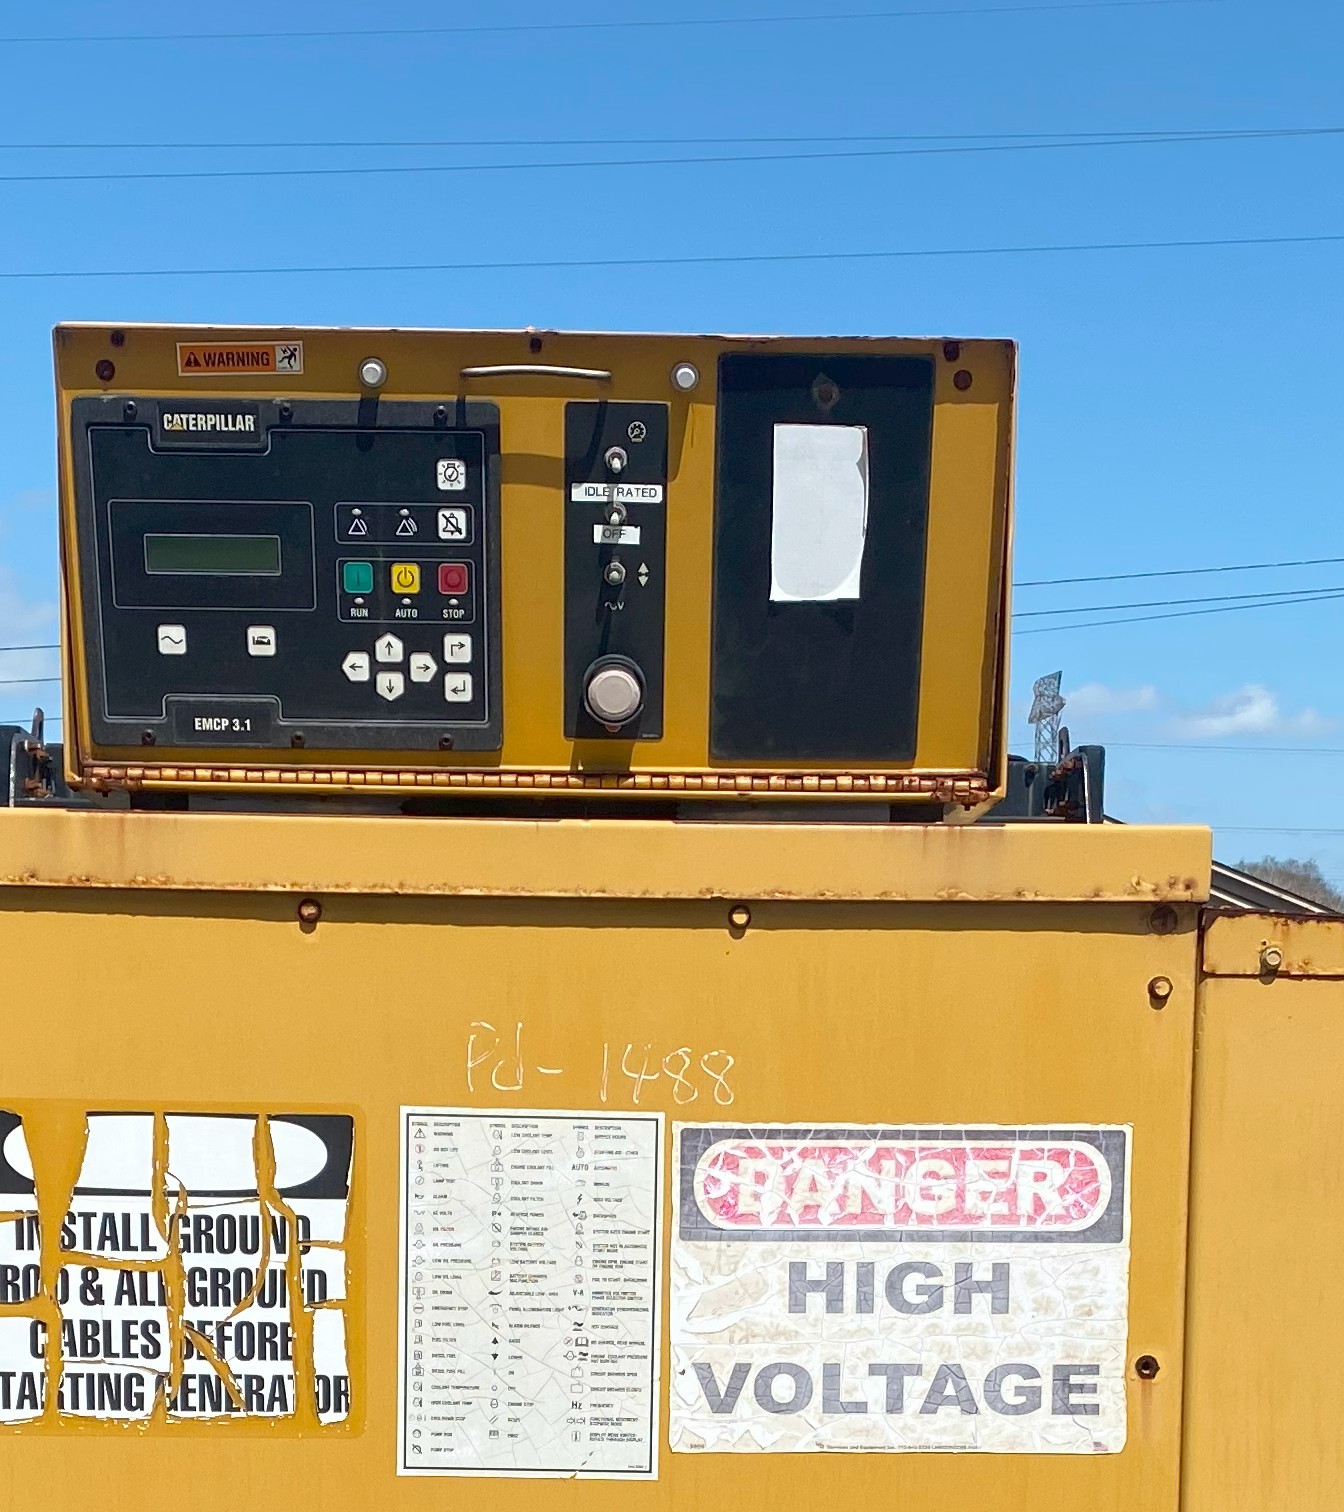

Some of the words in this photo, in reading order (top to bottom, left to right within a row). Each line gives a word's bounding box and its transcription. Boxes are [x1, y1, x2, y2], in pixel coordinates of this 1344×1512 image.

[202, 351, 270, 367] WARNING
[163, 413, 255, 432] CATERPILLAR
[584, 486, 610, 498] IDLE
[616, 487, 658, 499] RATED
[602, 528, 627, 539] OFF
[350, 607, 368, 618] RUN
[395, 608, 418, 619] AUTO
[442, 609, 465, 619] STOP
[194, 717, 229, 731] EMCP
[232, 718, 251, 732] 3.1
[738, 1157, 1070, 1216] DANGER
[79, 1266, 105, 1307] &
[787, 1261, 1011, 1316] HIGH
[691, 1362, 1101, 1417] VOLTAGE
